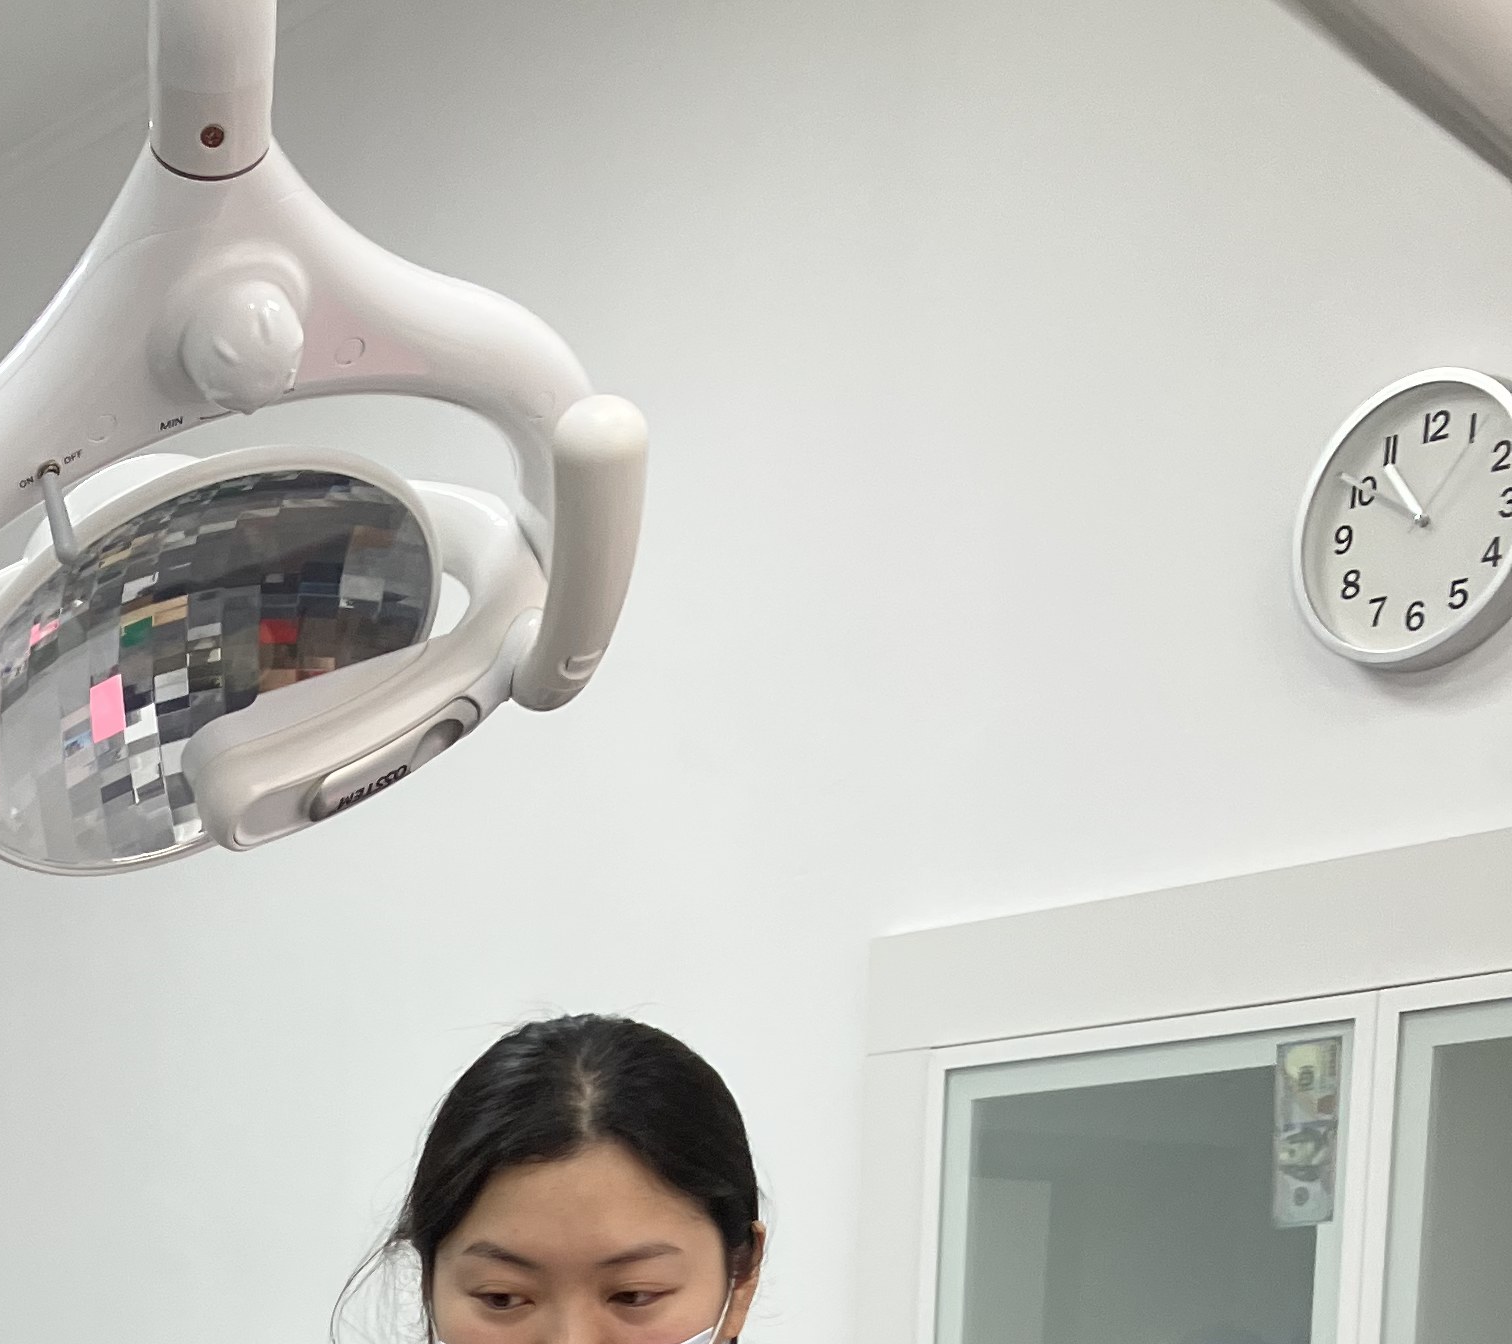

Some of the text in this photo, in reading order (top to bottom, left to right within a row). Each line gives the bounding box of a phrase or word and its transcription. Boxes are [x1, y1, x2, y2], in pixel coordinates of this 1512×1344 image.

[159, 416, 184, 431] MIN
[1422, 409, 1451, 444] 12
[1469, 412, 1478, 444] 1
[63, 449, 83, 465] OFF
[1383, 434, 1399, 467] 11
[1491, 439, 1512, 472] 2
[18, 476, 35, 489] ON
[1350, 475, 1378, 510] 10
[1498, 486, 1512, 518] 3
[1334, 524, 1354, 555] 9
[1481, 536, 1503, 568] 4
[1341, 568, 1361, 600] 8
[1448, 577, 1469, 610] 5
[1369, 596, 1388, 627] 7
[1405, 600, 1425, 632] 6
